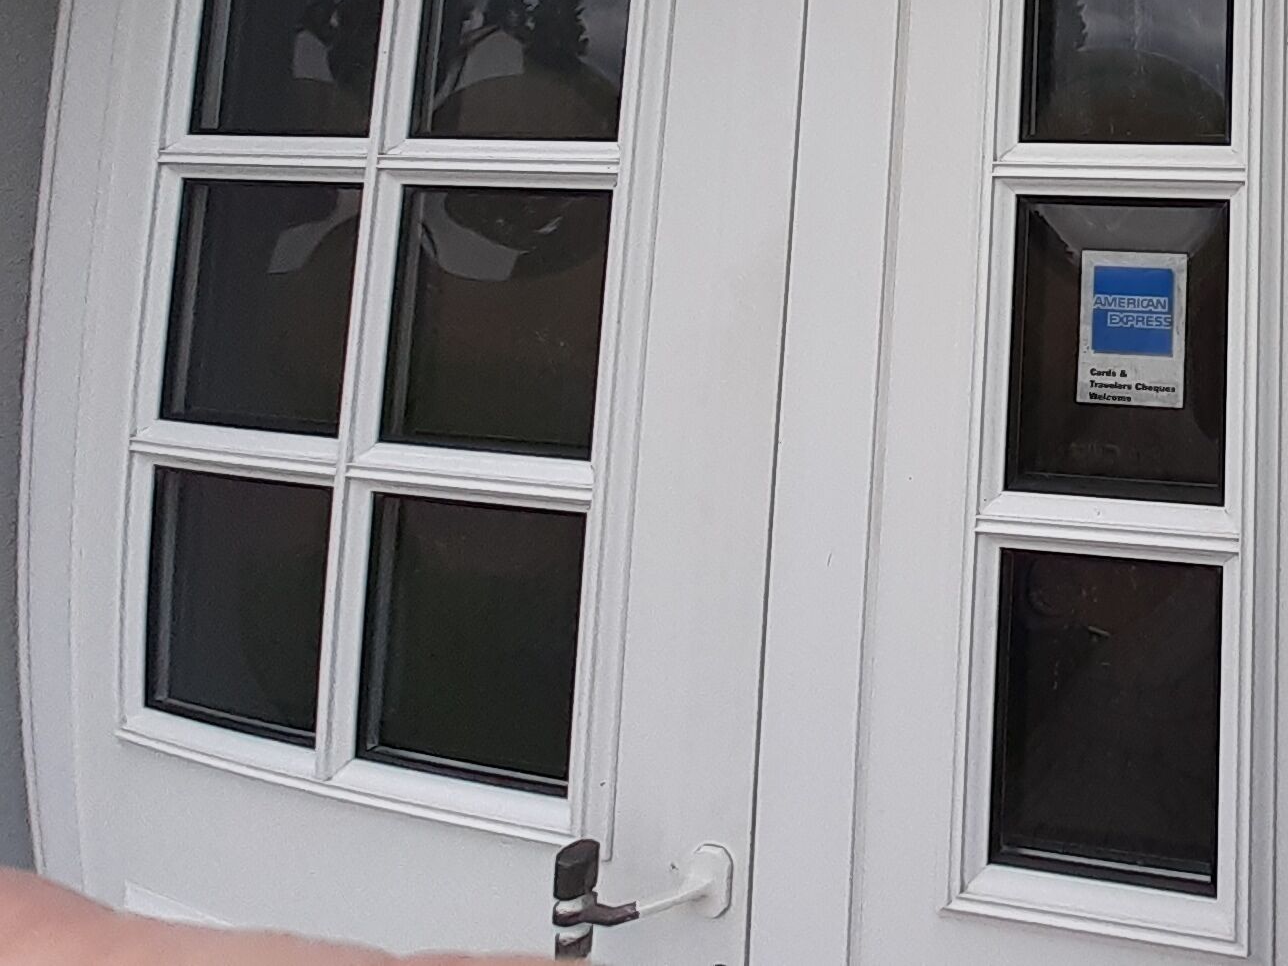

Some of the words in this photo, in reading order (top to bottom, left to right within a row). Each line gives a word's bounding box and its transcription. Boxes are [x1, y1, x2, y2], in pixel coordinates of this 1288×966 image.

[1093, 294, 1168, 312] AMERICAN
[1107, 312, 1172, 329] EXPRESS
[1089, 367, 1117, 378] Cards
[1119, 369, 1128, 378] &
[1088, 392, 1132, 402] Welcome
